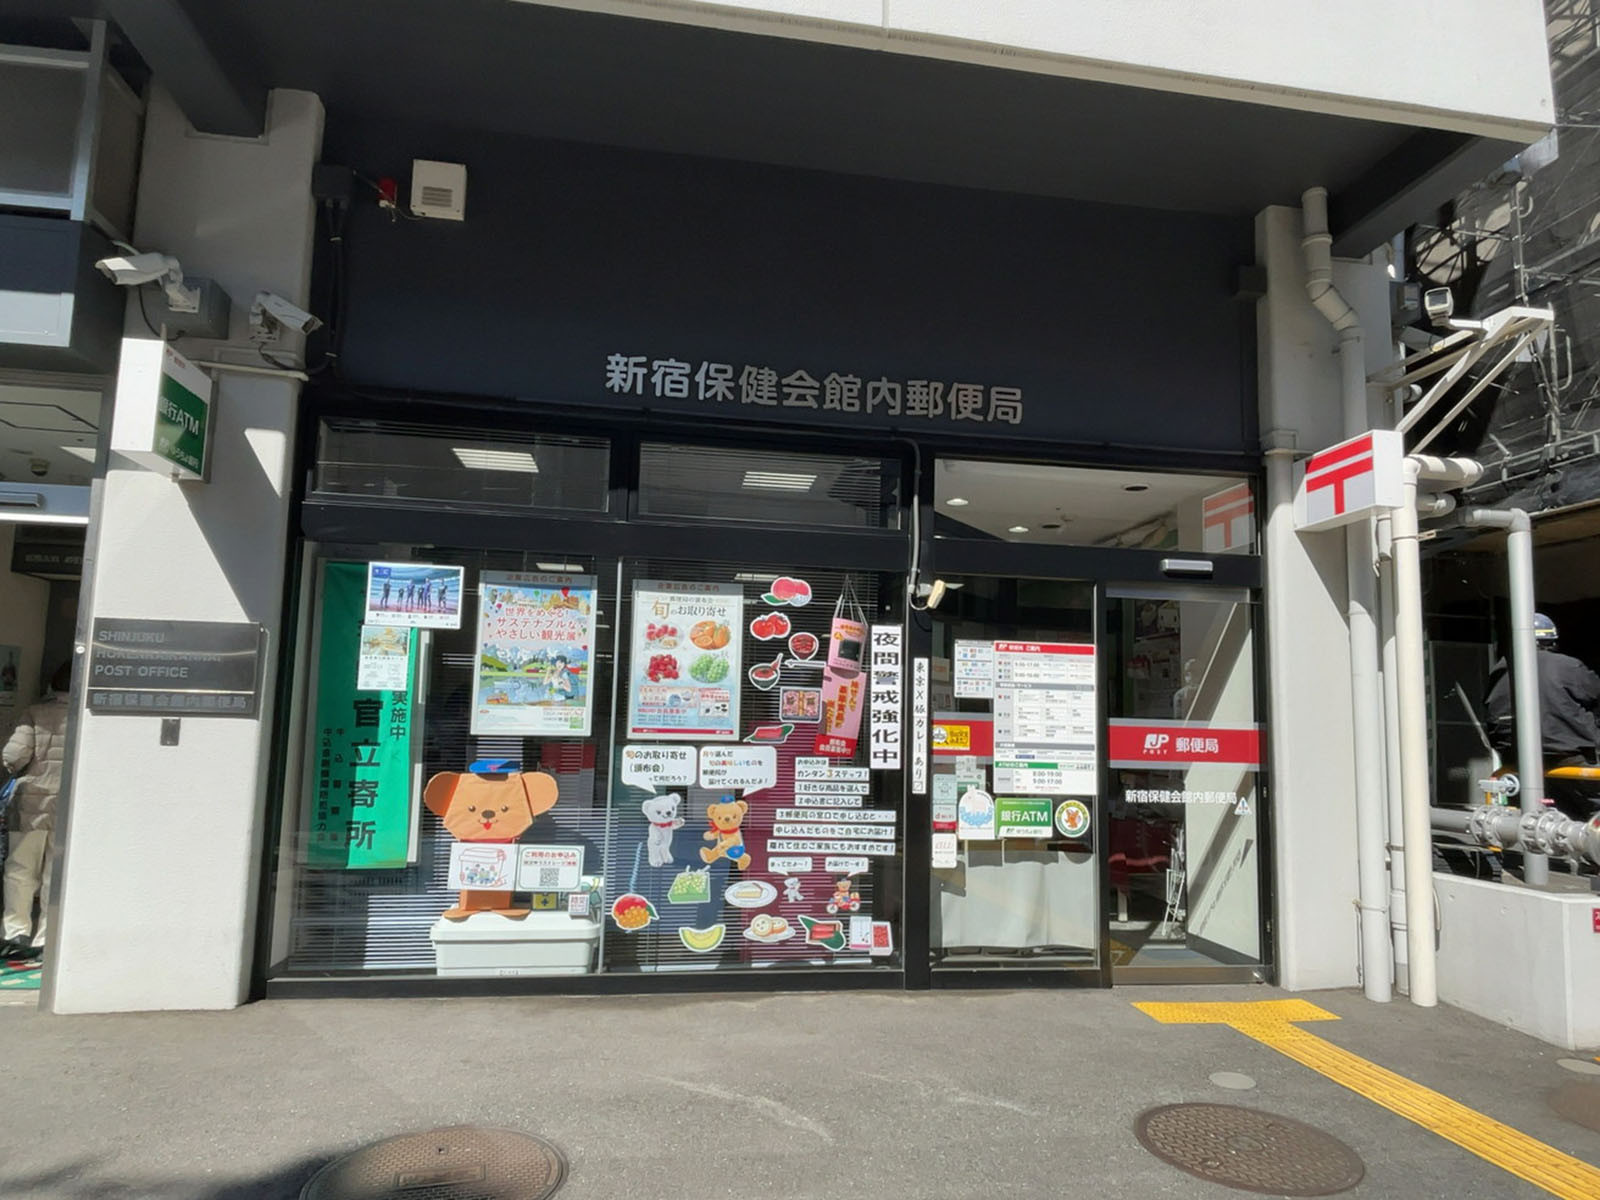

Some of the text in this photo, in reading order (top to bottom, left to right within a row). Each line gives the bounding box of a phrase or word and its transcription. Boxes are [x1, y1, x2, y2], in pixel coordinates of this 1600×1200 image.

[605, 352, 1024, 425] 新宿保健会館内郵便局
[652, 600, 727, 621] 旬のお取り寄せ
[98, 630, 166, 643] SHINJUKU
[495, 629, 577, 642] やさしい観光展
[95, 664, 188, 678] POST OFFICE
[871, 632, 901, 765] 夜間警戒強化中
[390, 690, 409, 741] 実施中
[1175, 737, 1220, 754] 郵便局
[1125, 789, 1238, 804] 新宿保健会館内郵便局
[1001, 810, 1048, 822] 銀行ATM
